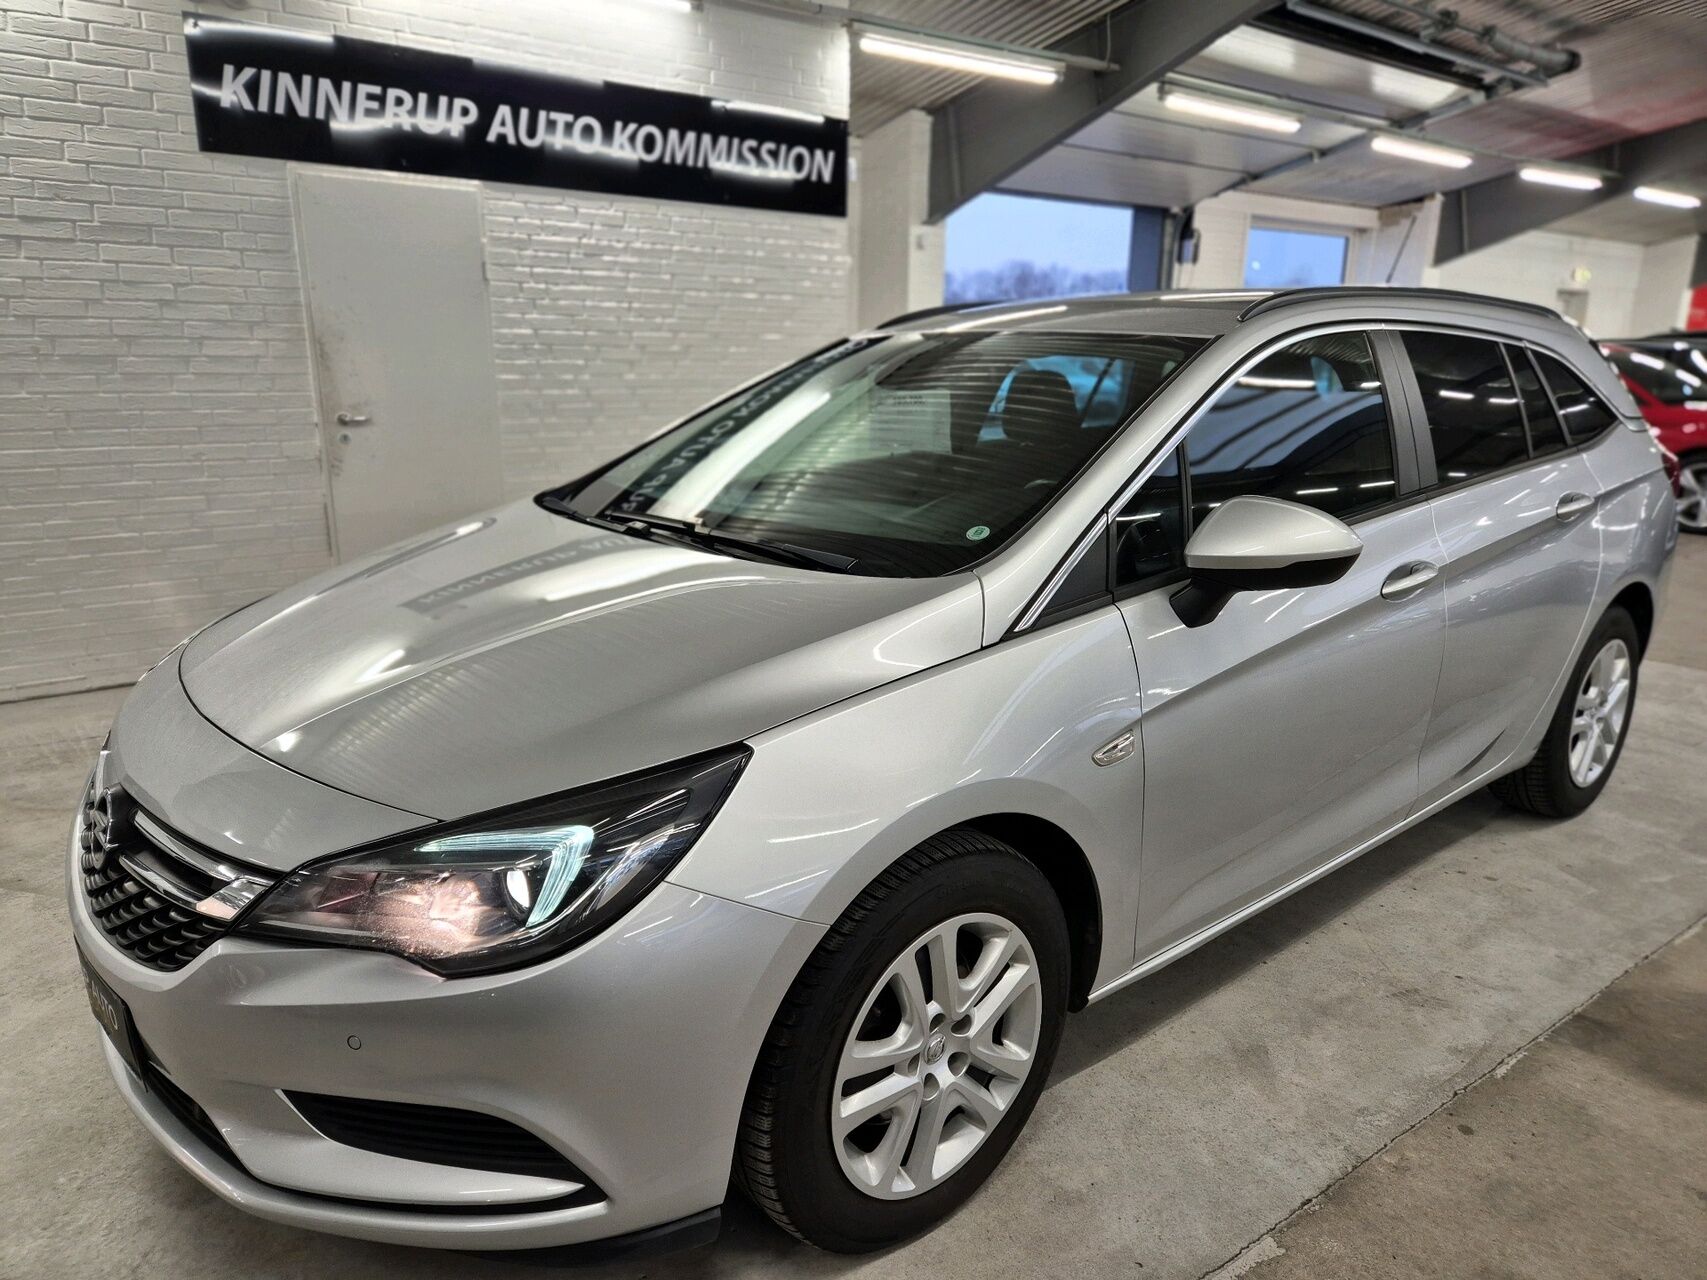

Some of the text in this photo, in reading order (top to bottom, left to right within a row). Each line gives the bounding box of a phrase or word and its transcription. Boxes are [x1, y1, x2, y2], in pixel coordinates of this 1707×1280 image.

[219, 63, 835, 184] KINNERUP AUTO KOMMISSION
